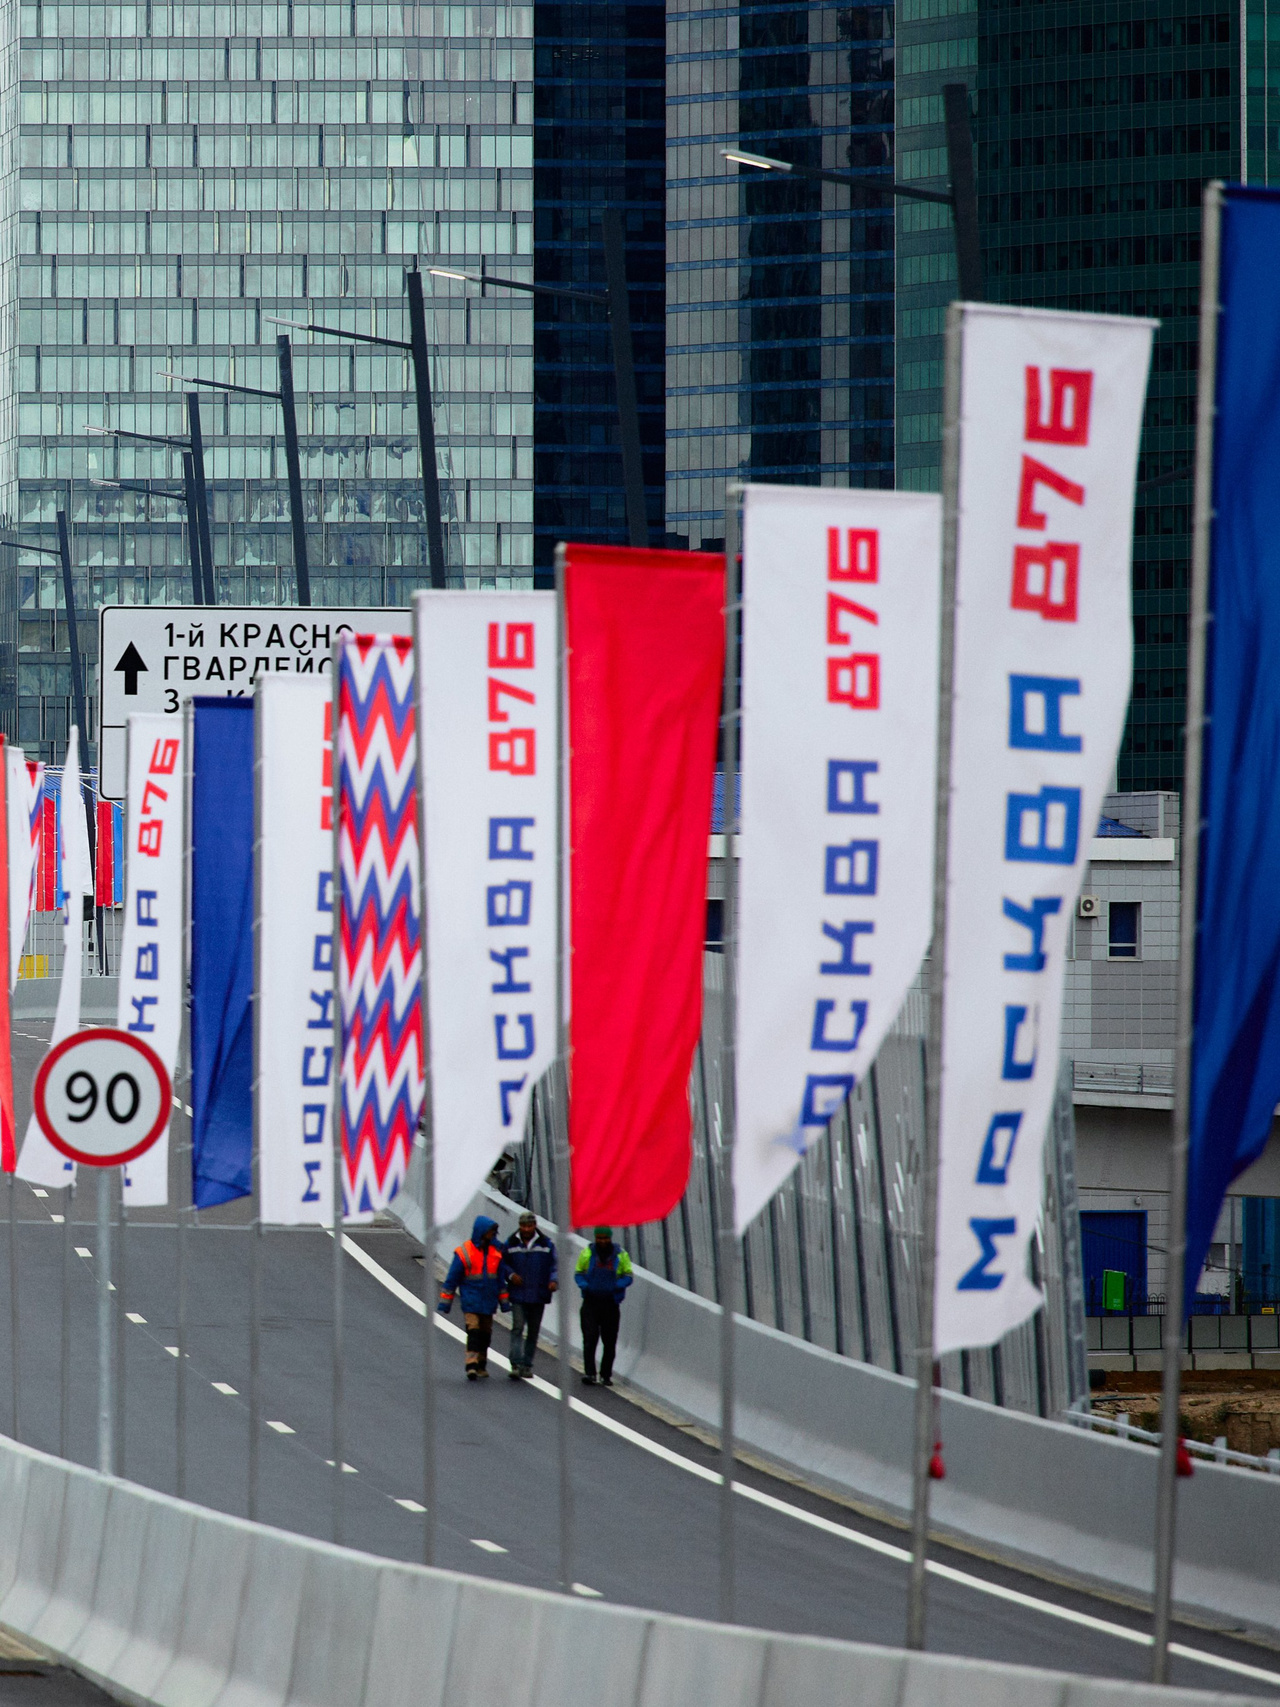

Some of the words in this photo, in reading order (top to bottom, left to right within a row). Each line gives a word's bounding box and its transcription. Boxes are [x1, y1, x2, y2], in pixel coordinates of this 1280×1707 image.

[1008, 365, 1093, 623] 876
[164, 622, 204, 648] 1-й
[487, 622, 536, 776] 876
[826, 526, 880, 711] 876
[137, 738, 180, 858] 876
[486, 816, 536, 1127] СКВА
[798, 759, 879, 1142] ОСКВА
[957, 673, 1083, 1293] МОСКВА
[65, 1069, 141, 1125] 90
